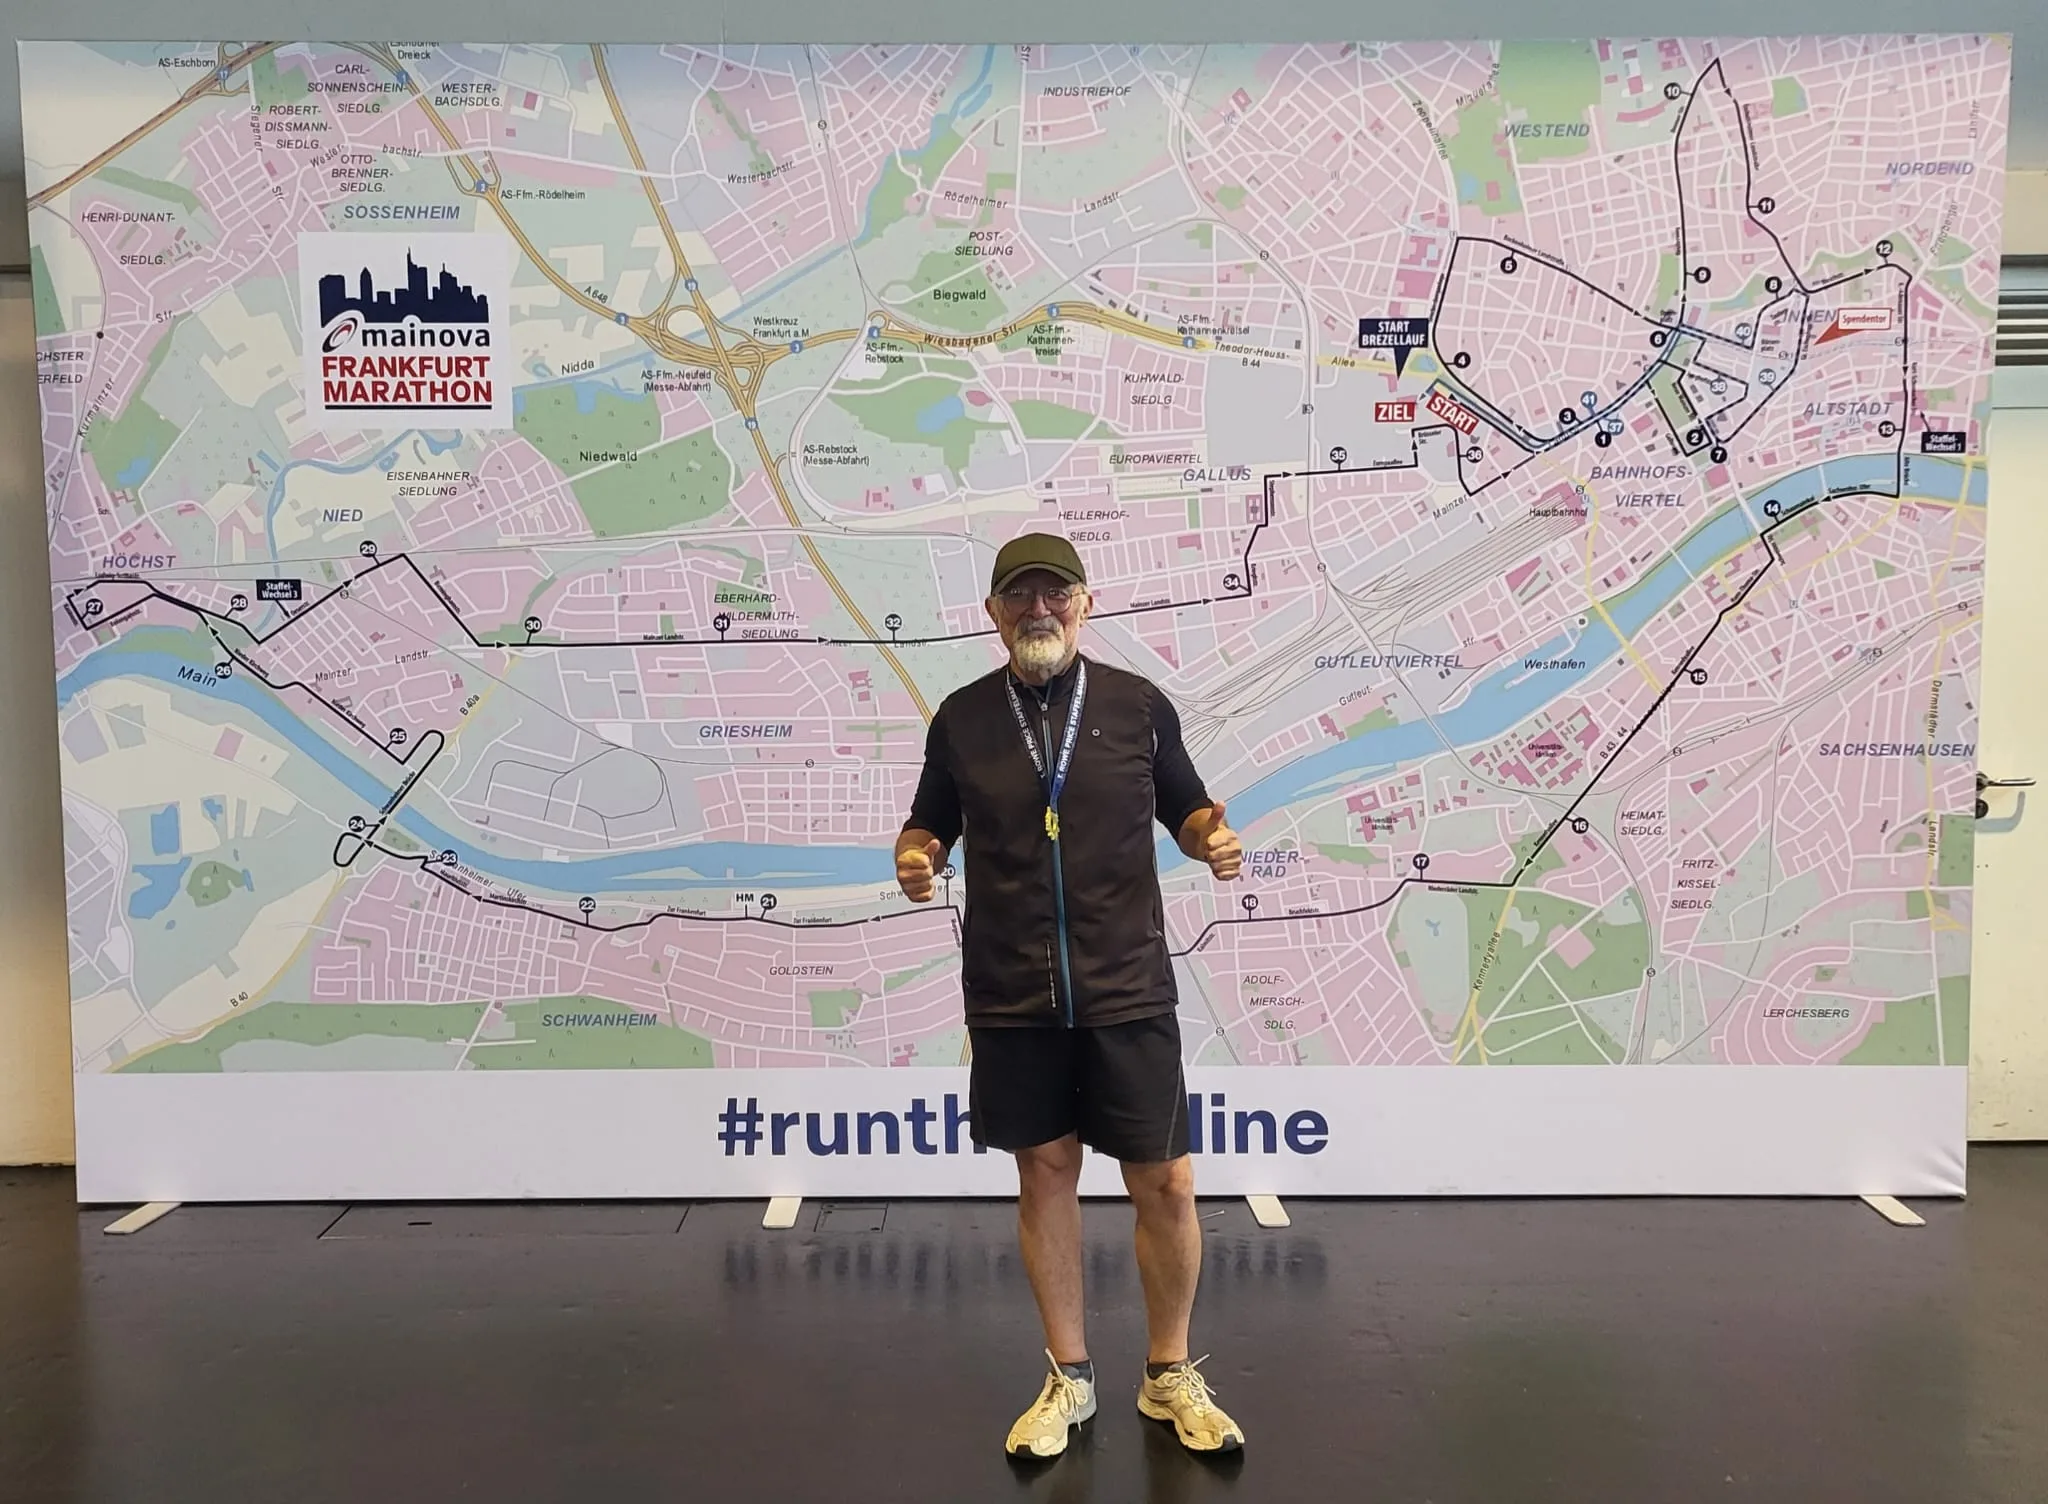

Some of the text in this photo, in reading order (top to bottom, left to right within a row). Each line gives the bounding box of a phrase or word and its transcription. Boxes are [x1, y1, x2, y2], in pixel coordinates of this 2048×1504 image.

[398, 50, 431, 60] Dreieck
[158, 57, 216, 68] AS-Eschborn
[335, 64, 370, 74] CARL-
[307, 82, 408, 93] SONNENSCHEIN-
[441, 83, 497, 94] WESTER-
[1043, 86, 1131, 97] INDUSTRIEHOF
[1667, 86, 1680, 98] 10
[434, 96, 503, 107] BACHSDLG.
[269, 105, 322, 115] ROBERT-
[337, 103, 383, 114] SIEDLG.
[265, 122, 333, 132] DISSMANN-
[1503, 123, 1590, 138] WESTEND
[341, 155, 377, 165] OTTO-
[331, 168, 393, 179] BRENNER-
[727, 161, 797, 185] Westerbachstr.
[1885, 162, 1975, 176] NORDEND
[339, 182, 385, 192] SIEDLG.
[500, 190, 586, 201] AS-Ffm.-Rödelheim
[944, 190, 1121, 214] Rödelheimer Landstr.
[1761, 200, 1772, 211] 11
[82, 212, 176, 223] HENRI-DUNANT-
[344, 205, 460, 220] SOSSENHEIM
[968, 231, 1003, 242] POST-
[954, 246, 1013, 257] SIEDLUNG
[1878, 242, 1892, 254] 12
[120, 255, 166, 266] SIEDLG.
[584, 285, 609, 305] A 648
[933, 290, 986, 302] Biegwald
[156, 309, 177, 325] Str.
[754, 316, 799, 327] Westkreuz
[1842, 313, 1887, 326] Spendentor
[1377, 320, 1411, 333] START
[1737, 326, 1751, 337] 40
[362, 323, 490, 347] mainova
[753, 328, 791, 339] Frankfurt
[923, 332, 999, 347] Wiesbadener
[1361, 334, 1426, 347] BREZELLAUF
[1214, 341, 1291, 360] Theodor-Heuss-
[865, 354, 904, 364] Rebstock
[1242, 357, 1261, 369] B 44
[1330, 355, 1356, 369] Allee
[322, 356, 491, 378] FRANKFURT
[561, 359, 595, 376] Nidda
[37, 374, 83, 384] ERFELD
[641, 370, 712, 381] AS-Ffm.-Neufeld
[1124, 373, 1185, 384] KUHWALD-
[1760, 371, 1775, 383] 39
[323, 381, 492, 402] MARATHON
[643, 382, 712, 393] (Messe-Abfahrt)
[1582, 394, 1596, 406] 41
[76, 376, 116, 439] Kurmainzer
[1376, 404, 1413, 420] ZIEL
[1803, 401, 1894, 416] ALTSTADT
[1429, 395, 1477, 434] START
[1608, 422, 1623, 433] 37
[1879, 424, 1894, 435] 13
[803, 445, 858, 455] AS-Rebstock
[1331, 449, 1346, 461] 35
[1467, 450, 1482, 461] 36
[579, 451, 638, 463] Niedwald
[802, 456, 870, 467] (Messe-Abfahrt)
[1109, 454, 1203, 465] EUROPAVIERTEL
[386, 471, 471, 482] EISENBAHNER
[1183, 468, 1252, 482] GALLUS
[1590, 465, 1693, 480] BAHNHOFS-
[398, 486, 458, 497] SIEDLUNG
[1615, 494, 1686, 508] VIERTEL
[1432, 494, 1469, 521] Mainzer
[1529, 507, 1588, 519] Hauptbahnhof
[1765, 504, 1780, 515] 14
[322, 509, 364, 522] NIED
[1058, 510, 1130, 521] HELLERHOF-
[1070, 531, 1113, 542] SIEDLG.
[361, 544, 376, 556] 29
[102, 552, 177, 569] HÖCHST
[265, 581, 294, 592] Staffel-
[1224, 576, 1239, 588] 34
[261, 590, 292, 600] Wechsel
[714, 594, 781, 605] EBERHARD-
[87, 602, 101, 613] 27
[232, 597, 247, 609] 28
[526, 619, 541, 631] 30
[715, 618, 729, 629] 31
[886, 616, 900, 628] 32
[741, 629, 799, 639] SIEDLUNG
[314, 650, 431, 683] Mainzer Landstr.
[1314, 655, 1463, 669] GUTLEUTVIERTEL
[1524, 658, 1586, 670] Westhafen
[178, 665, 218, 688] Main
[216, 665, 231, 677] 26
[1692, 671, 1706, 683] 15
[1339, 684, 1373, 707] Gutleut-
[464, 693, 481, 711] 40a
[391, 731, 406, 743] 25
[700, 724, 793, 738] GRIESHEIM
[1616, 726, 1629, 740] 44
[1022, 727, 1044, 772] ROWE PRICE
[1059, 727, 1076, 772] ROWE PRICE
[1819, 743, 1976, 757] SACHSENHAUSEN
[1621, 811, 1667, 821] HEIMAT-
[349, 819, 365, 830] 24
[1573, 819, 1588, 832] 16
[1621, 826, 1665, 836] SIEDLG.
[443, 853, 457, 864] 23
[1240, 851, 1305, 864] NIEDER-
[1414, 856, 1429, 868] 17
[1682, 859, 1718, 869] FRITZ-
[940, 866, 955, 878] 20
[1251, 865, 1287, 878] RAD
[1677, 879, 1720, 889] KISSEL-
[735, 893, 755, 903] HM
[761, 896, 776, 908] 21
[1243, 897, 1257, 908] 18
[580, 899, 595, 911] 22
[1472, 930, 1502, 992] Kennedyallee
[769, 966, 834, 976] GOLDSTEIN
[1243, 975, 1285, 986] ADOLF-
[237, 990, 250, 1004] 40
[1250, 997, 1305, 1007] MIERSCH-
[1763, 1008, 1850, 1019] LERCHESBERG
[542, 1013, 658, 1028] SCHWANHEIM
[1264, 1020, 1296, 1030] SDLG.
